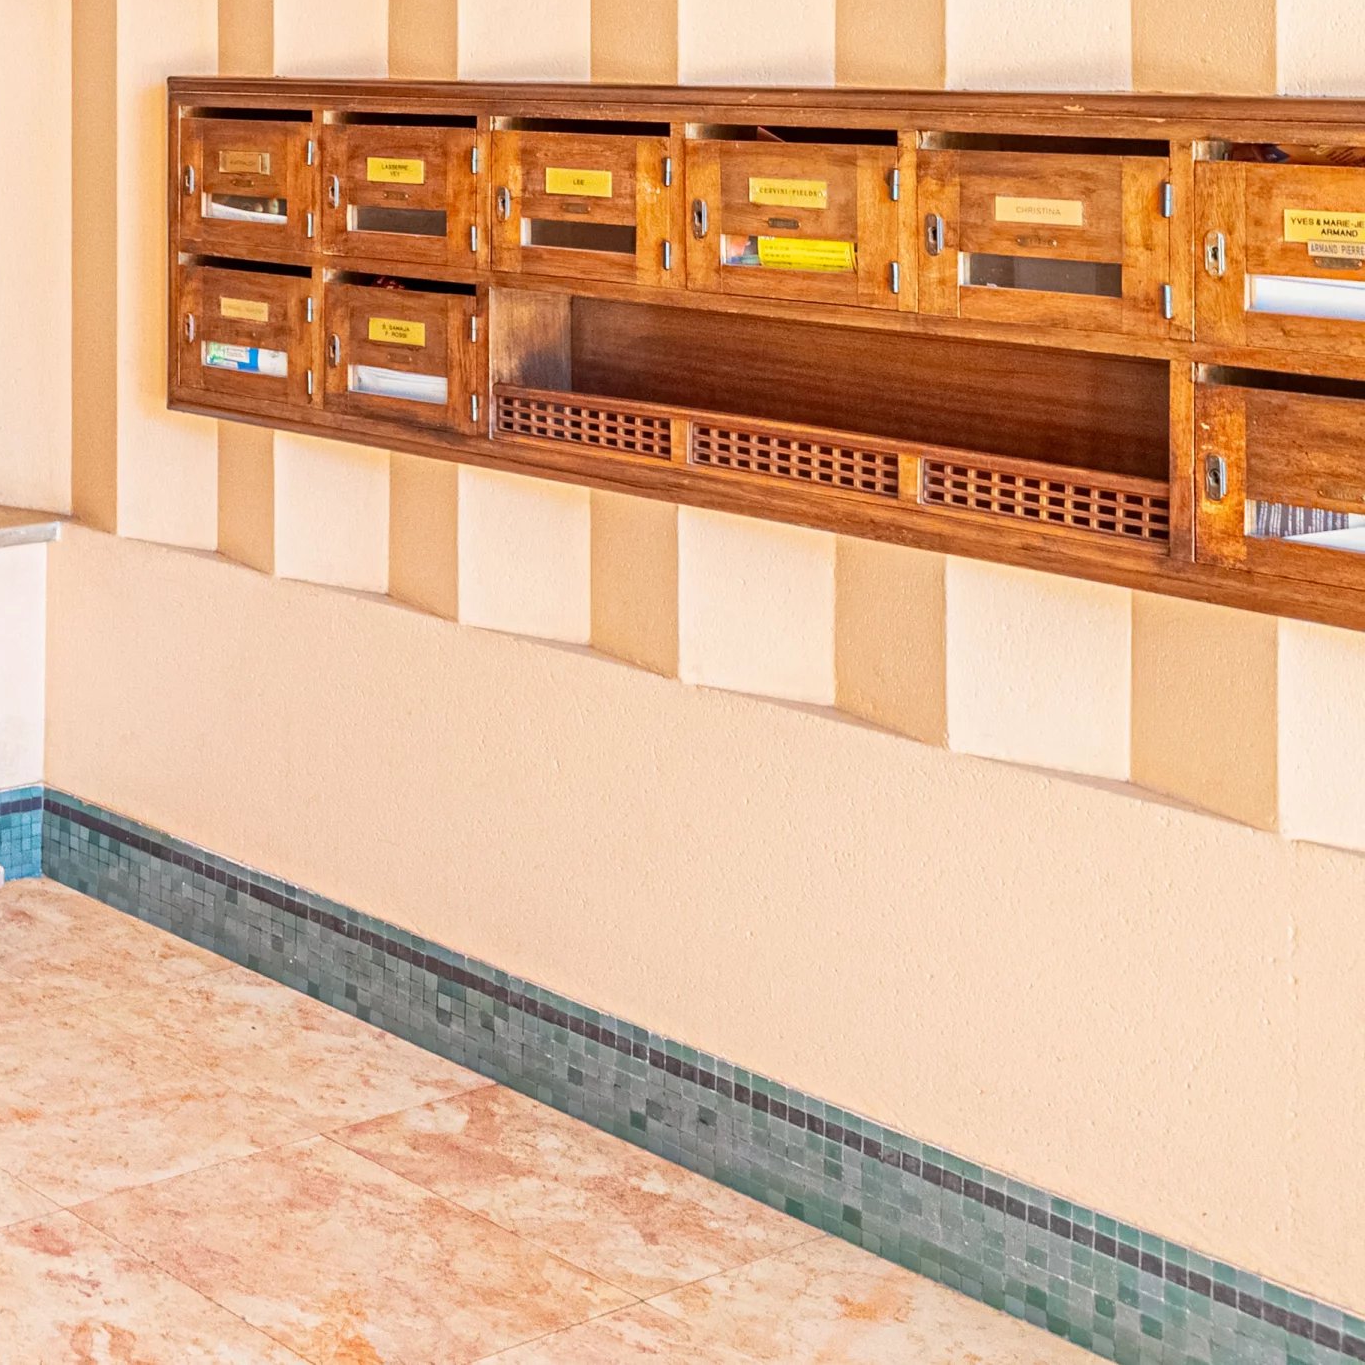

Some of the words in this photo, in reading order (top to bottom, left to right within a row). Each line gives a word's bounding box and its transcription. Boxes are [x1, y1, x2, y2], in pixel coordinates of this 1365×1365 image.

[1015, 206, 1062, 216] CHRISTINA
[1290, 217, 1314, 225] YVES
[1316, 218, 1321, 226] &
[1321, 228, 1359, 238] ARMAND
